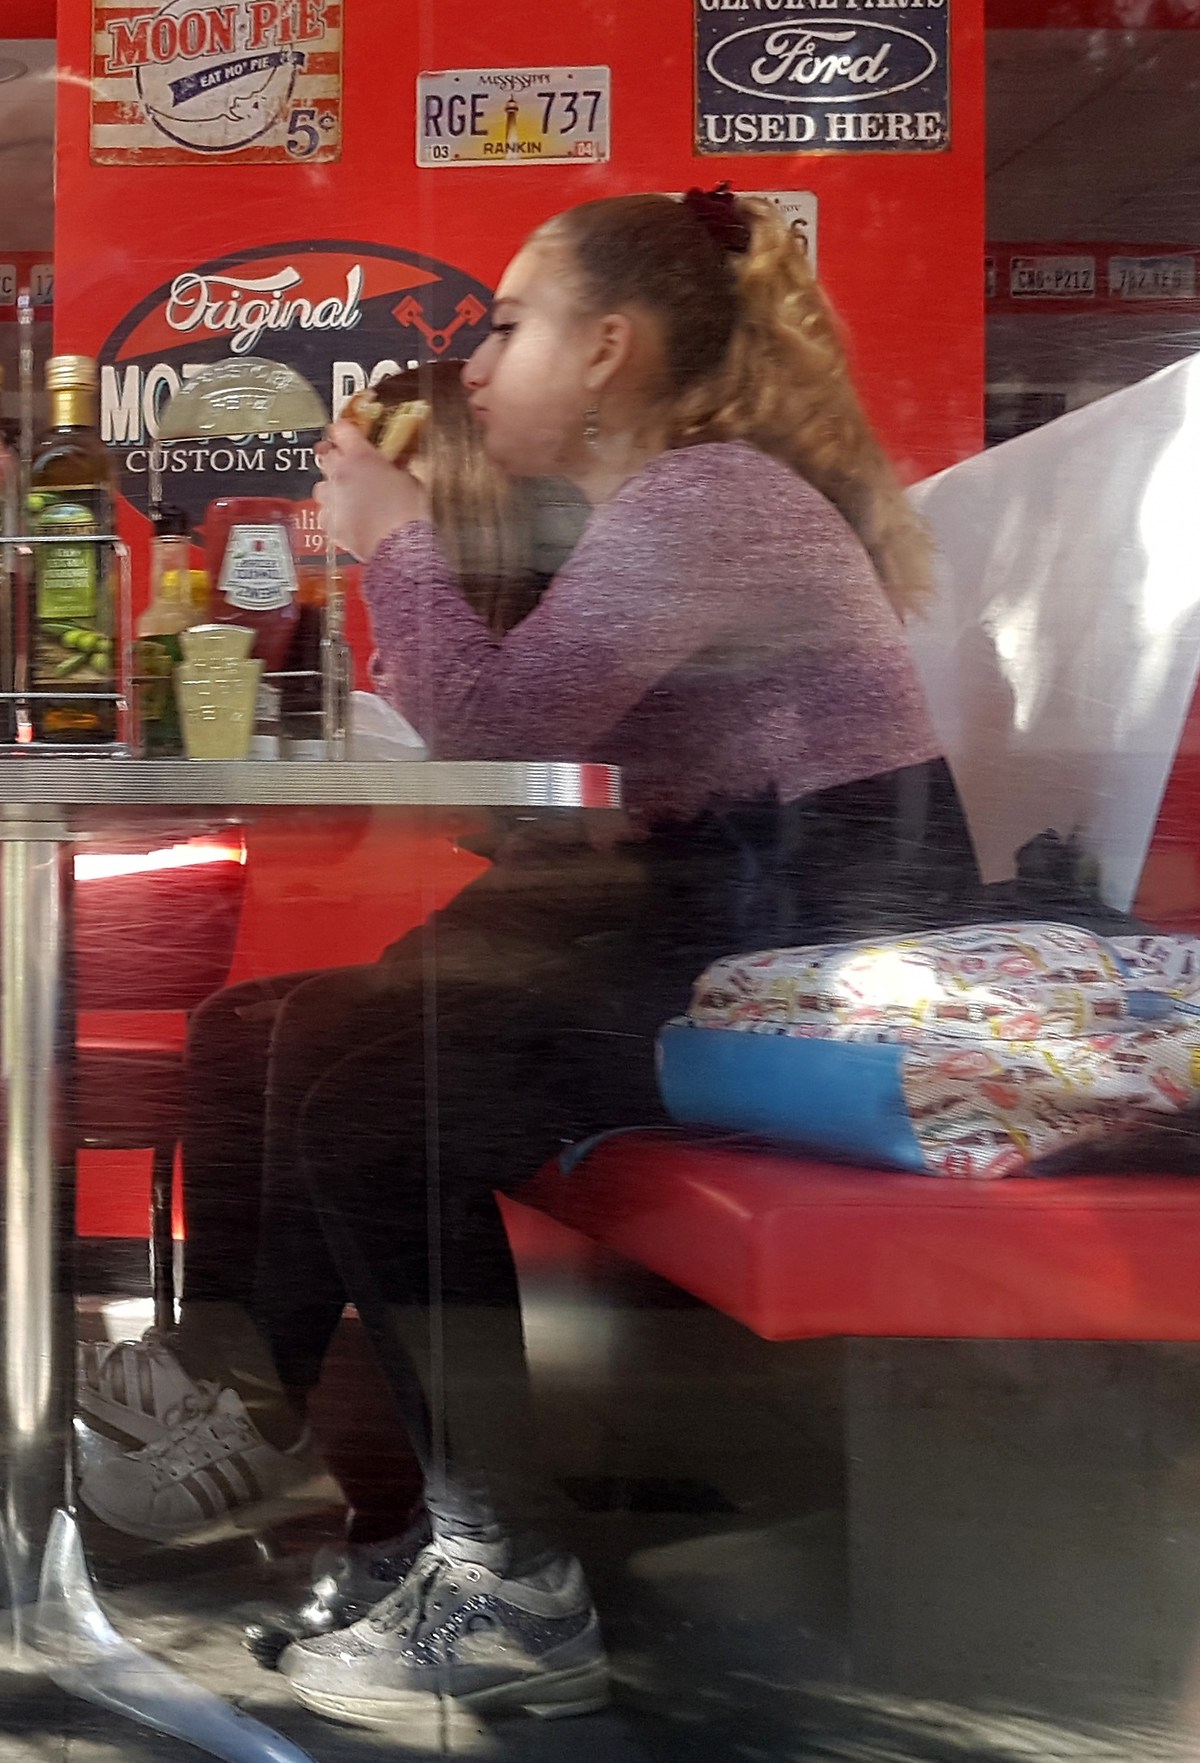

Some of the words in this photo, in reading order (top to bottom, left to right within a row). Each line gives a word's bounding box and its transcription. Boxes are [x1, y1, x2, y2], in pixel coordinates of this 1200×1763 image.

[109, 6, 237, 70] MOON
[751, 28, 892, 84] Ford
[200, 70, 221, 88] EAT
[249, 57, 270, 71] PIE
[424, 93, 489, 137] RGE
[537, 90, 601, 134] 737
[703, 114, 816, 143] USED
[825, 111, 942, 142] HERE
[433, 145, 449, 159] 03
[483, 142, 542, 155] RANKIN
[165, 264, 363, 355] Original
[125, 449, 266, 473] CUSTOM
